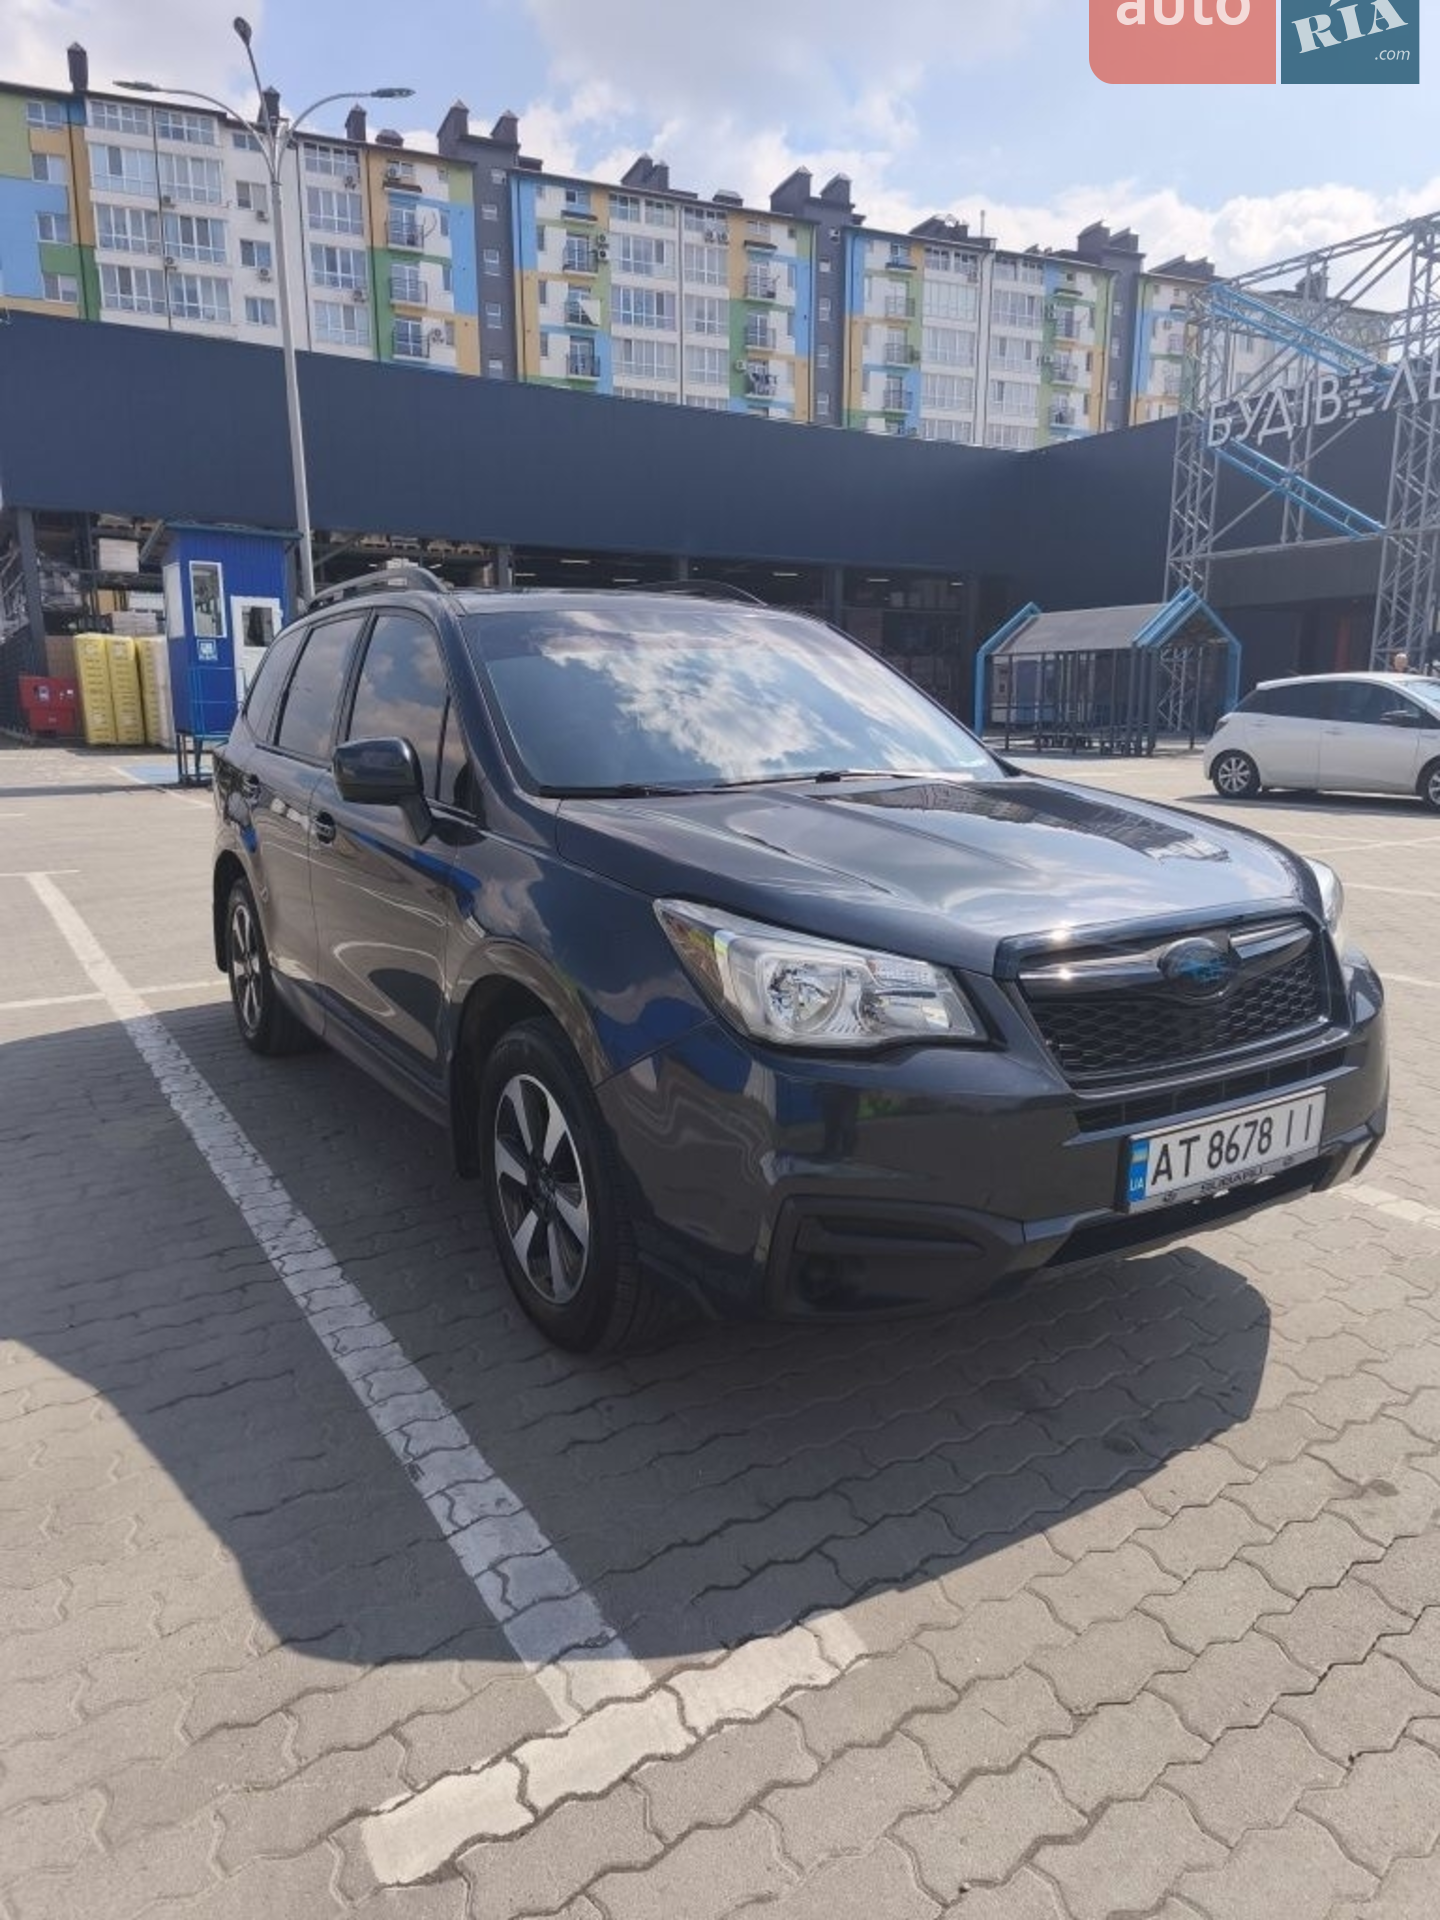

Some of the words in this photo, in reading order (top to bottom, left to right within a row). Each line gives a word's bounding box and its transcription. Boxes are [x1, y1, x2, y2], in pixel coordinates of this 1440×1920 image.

[1151, 1136, 1200, 1185] AT
[1207, 1116, 1273, 1169] 8678
[1130, 1177, 1144, 1191] UA
